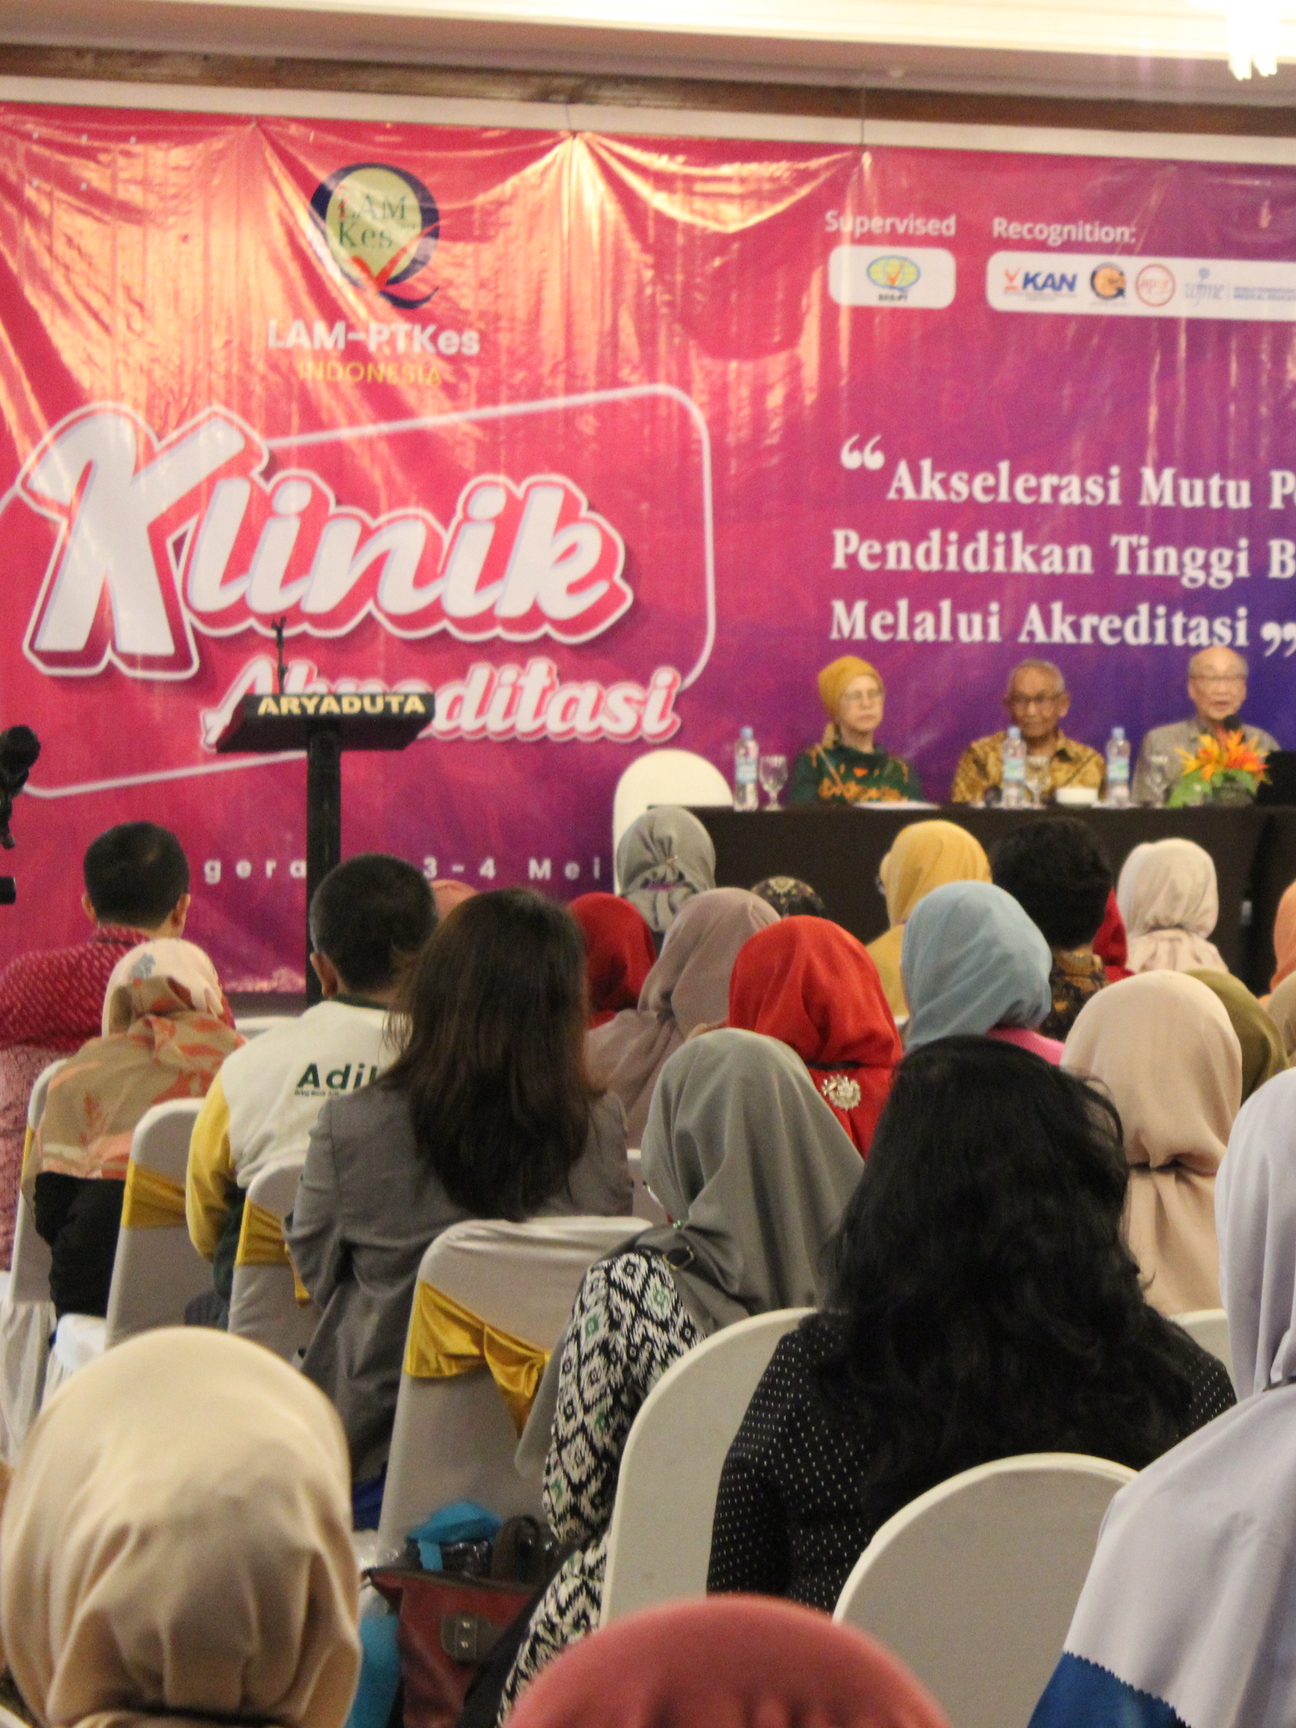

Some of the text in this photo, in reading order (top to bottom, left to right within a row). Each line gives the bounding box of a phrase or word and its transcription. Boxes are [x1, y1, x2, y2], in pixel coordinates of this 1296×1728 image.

[339, 221, 393, 248] Kes
[825, 209, 956, 237] Supervised
[992, 217, 1136, 246] Recognition:
[1022, 271, 1077, 292] KAN
[267, 318, 481, 355] LAM-PTKes
[299, 361, 443, 385] INDONESIA
[1139, 467, 1251, 509] Mutu
[20, 405, 630, 674] Klinik
[832, 528, 1094, 574] Pendidikan
[1111, 534, 1250, 589] Tinggi
[830, 598, 1002, 643] Melalui
[203, 656, 680, 746] Aditasi
[257, 695, 426, 716] ARYADUTA
[528, 856, 600, 881] Mei
